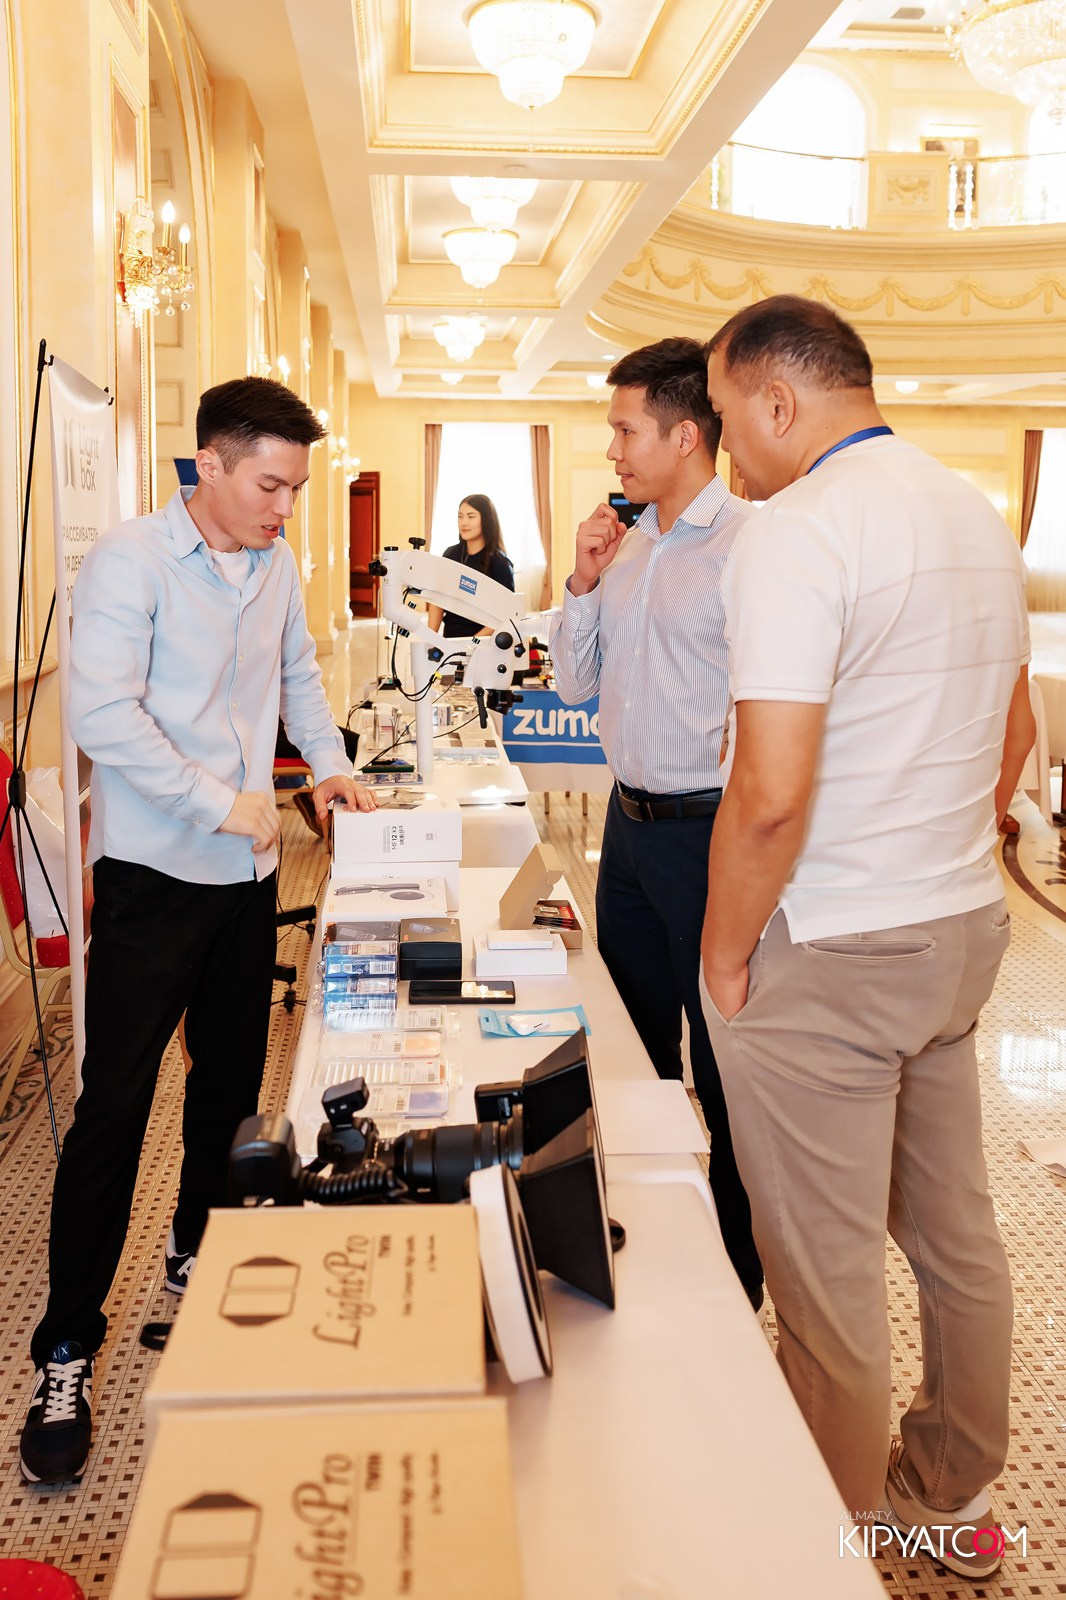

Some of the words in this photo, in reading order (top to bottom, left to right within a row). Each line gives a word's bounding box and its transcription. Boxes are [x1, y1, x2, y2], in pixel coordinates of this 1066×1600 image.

[78, 421, 99, 466] Light
[79, 457, 97, 492] box
[312, 1234, 377, 1349] LightPro
[291, 1452, 365, 1600] ightPro
